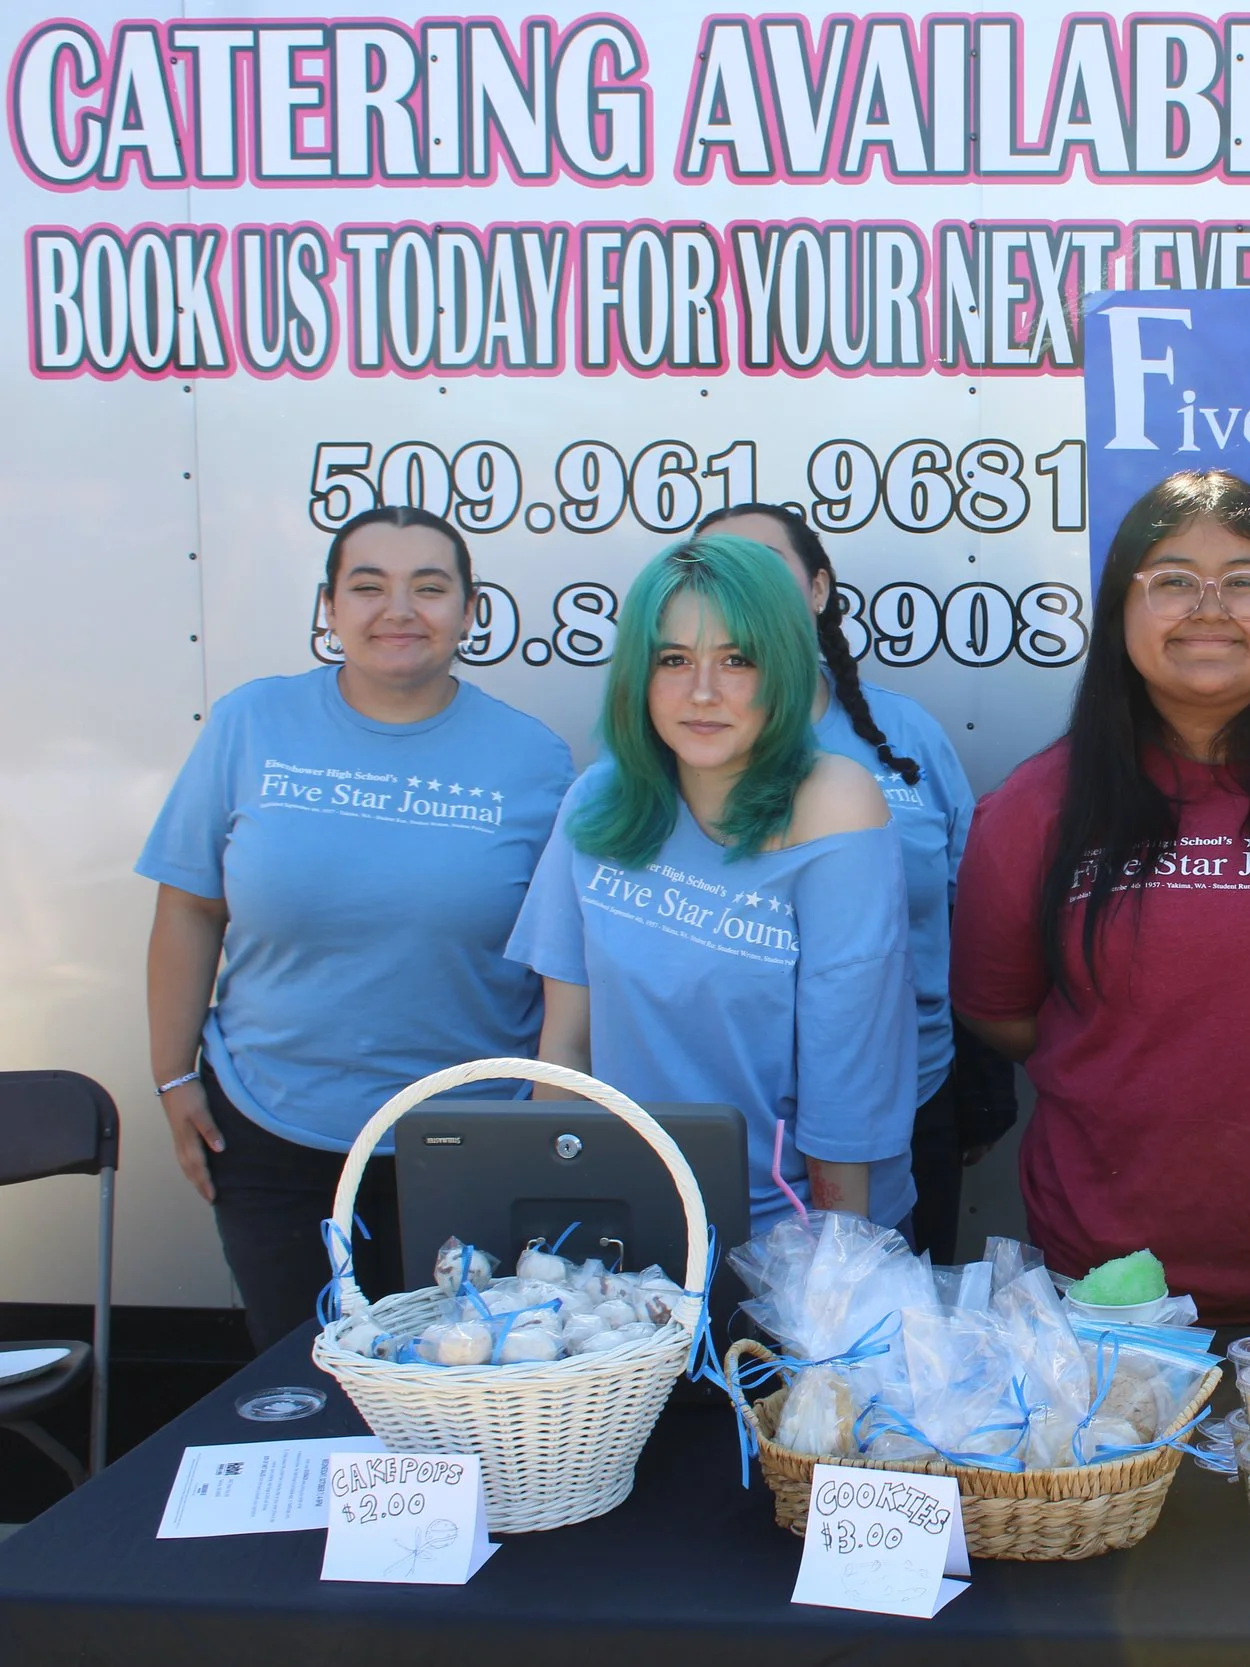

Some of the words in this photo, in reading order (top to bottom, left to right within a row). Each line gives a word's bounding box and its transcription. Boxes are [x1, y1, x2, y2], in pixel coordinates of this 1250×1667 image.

[11, 20, 647, 184] CATERING
[30, 226, 231, 374] BOOK
[239, 226, 333, 374] US
[341, 226, 569, 373] TODAY
[580, 226, 722, 372] FOR
[730, 224, 928, 370] YOUR
[264, 759, 325, 776] Eisenhower
[326, 768, 352, 780] High
[353, 770, 398, 784] School's
[260, 773, 323, 802] Five
[331, 783, 392, 810] Star
[397, 790, 502, 827] Journal
[1180, 836, 1233, 847] School's
[661, 864, 686, 883] High
[685, 875, 728, 898] School's
[1071, 859, 1142, 889] Fie
[1154, 851, 1229, 876] Star
[1166, 881, 1194, 890] Yakima,
[1212, 882, 1237, 890] Student
[585, 863, 653, 908] Five
[656, 887, 714, 929] Star
[713, 907, 800, 952] Journ
[331, 1456, 464, 1498] CAKEPOPS
[341, 1492, 426, 1525] $2.00
[815, 1480, 951, 1535] COOKIES
[820, 1518, 903, 1555] $3.00
